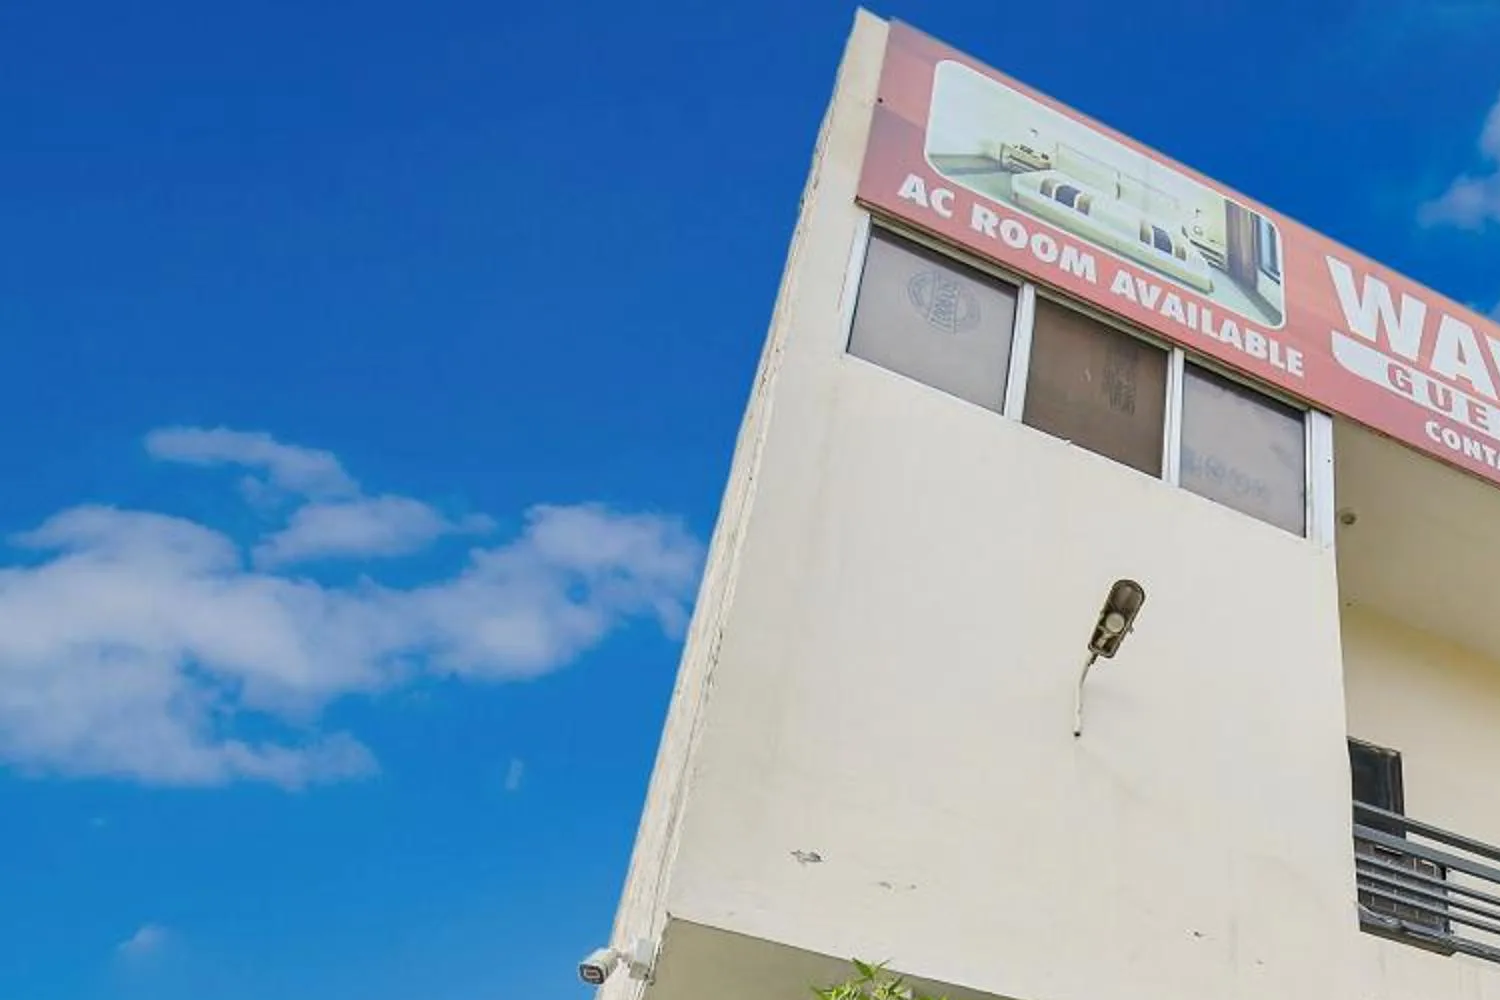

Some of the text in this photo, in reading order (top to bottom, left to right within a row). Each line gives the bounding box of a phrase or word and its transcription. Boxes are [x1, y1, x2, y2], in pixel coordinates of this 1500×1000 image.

[897, 173, 1304, 379] AC ROOM AVAILABLE
